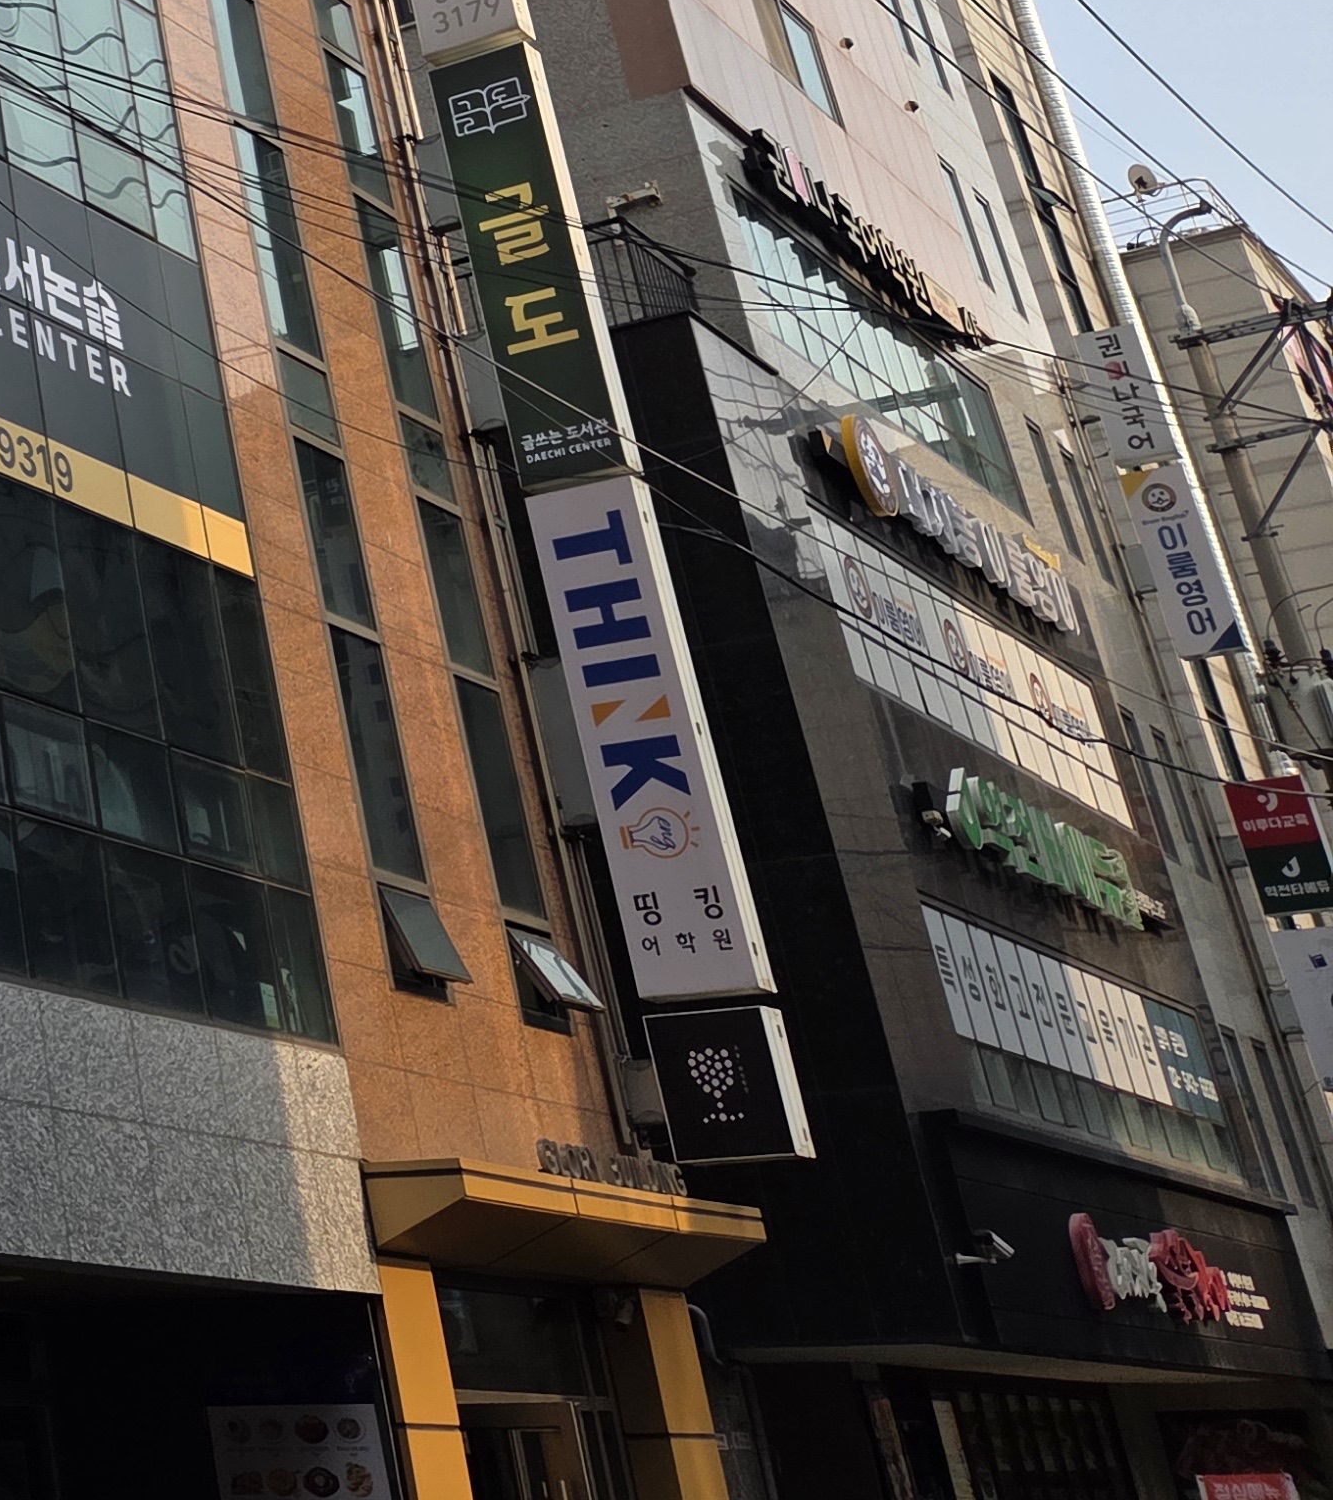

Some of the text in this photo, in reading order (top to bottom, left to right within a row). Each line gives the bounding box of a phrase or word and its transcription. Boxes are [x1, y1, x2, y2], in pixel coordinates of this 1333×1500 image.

[521, 429, 563, 451] 글쓰는
[526, 438, 612, 464] DAECHI CENTER
[1157, 523, 1218, 636] 이룸영어
[552, 510, 691, 811] THINK
[1243, 813, 1309, 832] 이루다교육
